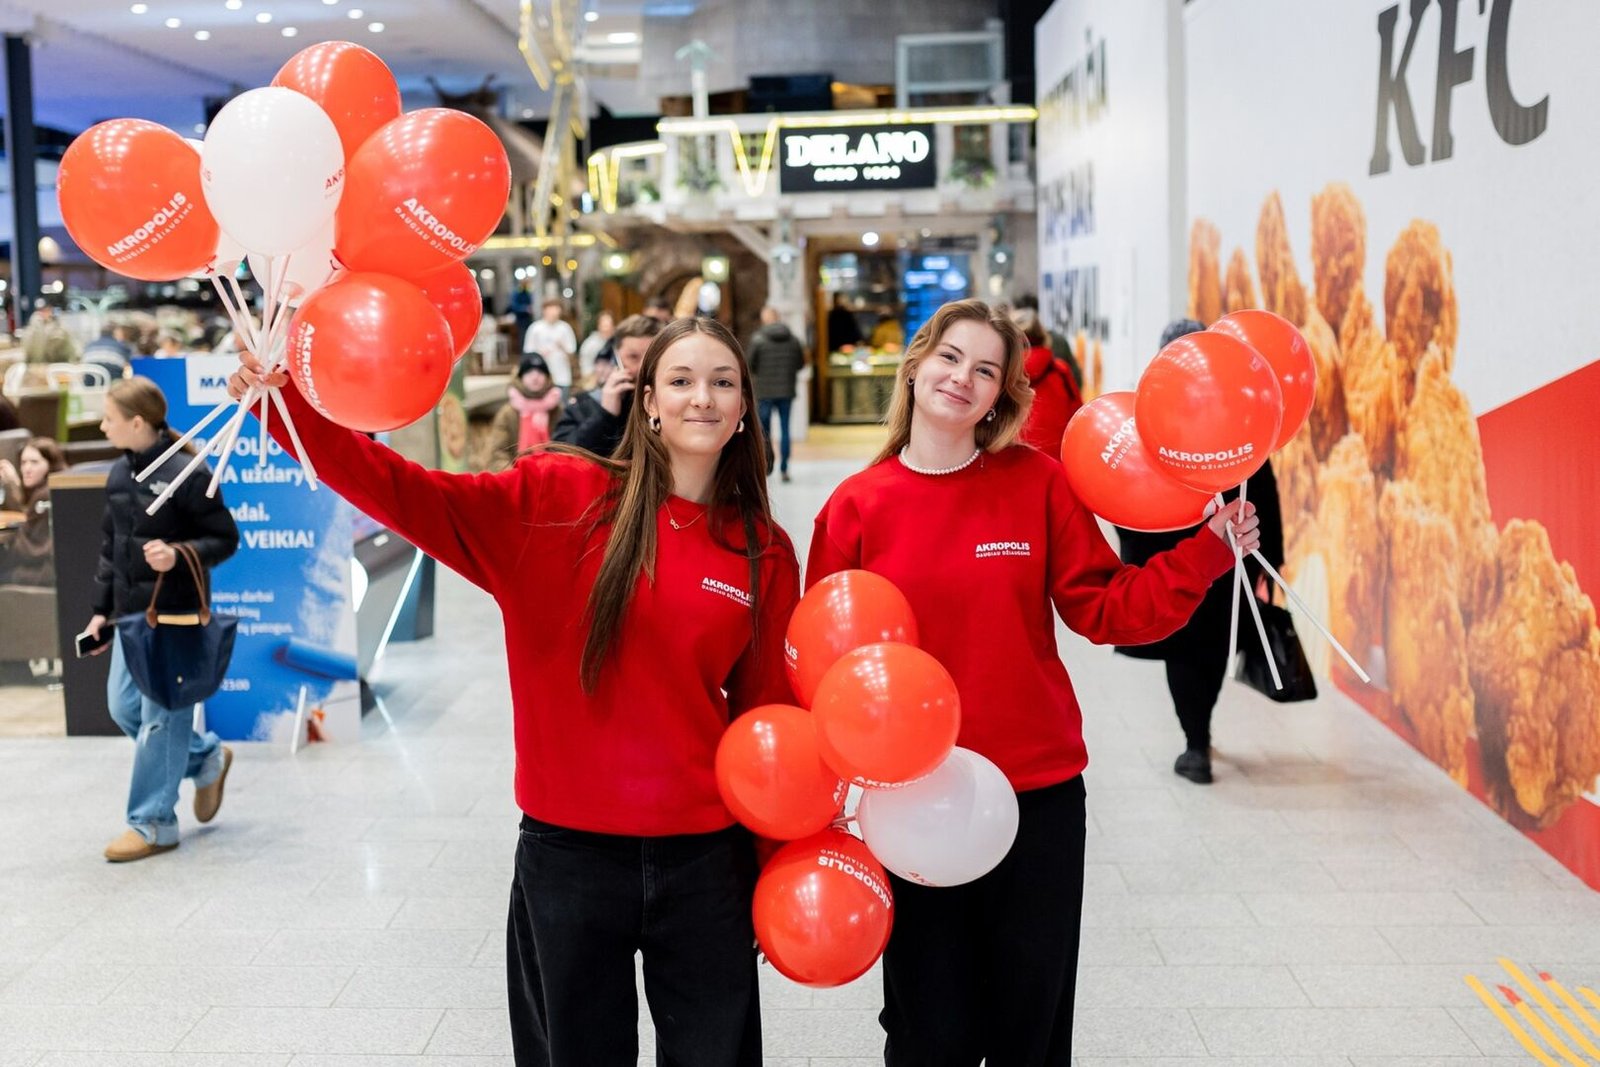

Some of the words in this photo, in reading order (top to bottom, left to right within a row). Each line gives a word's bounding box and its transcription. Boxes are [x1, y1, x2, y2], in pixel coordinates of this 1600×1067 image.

[1369, 0, 1549, 176] KFC
[785, 131, 930, 167] DELANO
[107, 192, 187, 256] AKROPOLIS
[394, 206, 431, 241] DAUGIAU
[403, 197, 477, 254] AKROPOLIS
[1158, 456, 1197, 471] DAUGIAU
[1201, 454, 1254, 471] DŽIAUGSMO
[1159, 443, 1254, 463] AKROPOLIS
[244, 529, 316, 550] VEIKIA!
[976, 541, 1031, 553] AKROPOLIS
[818, 856, 892, 910] AKROPOLIS
